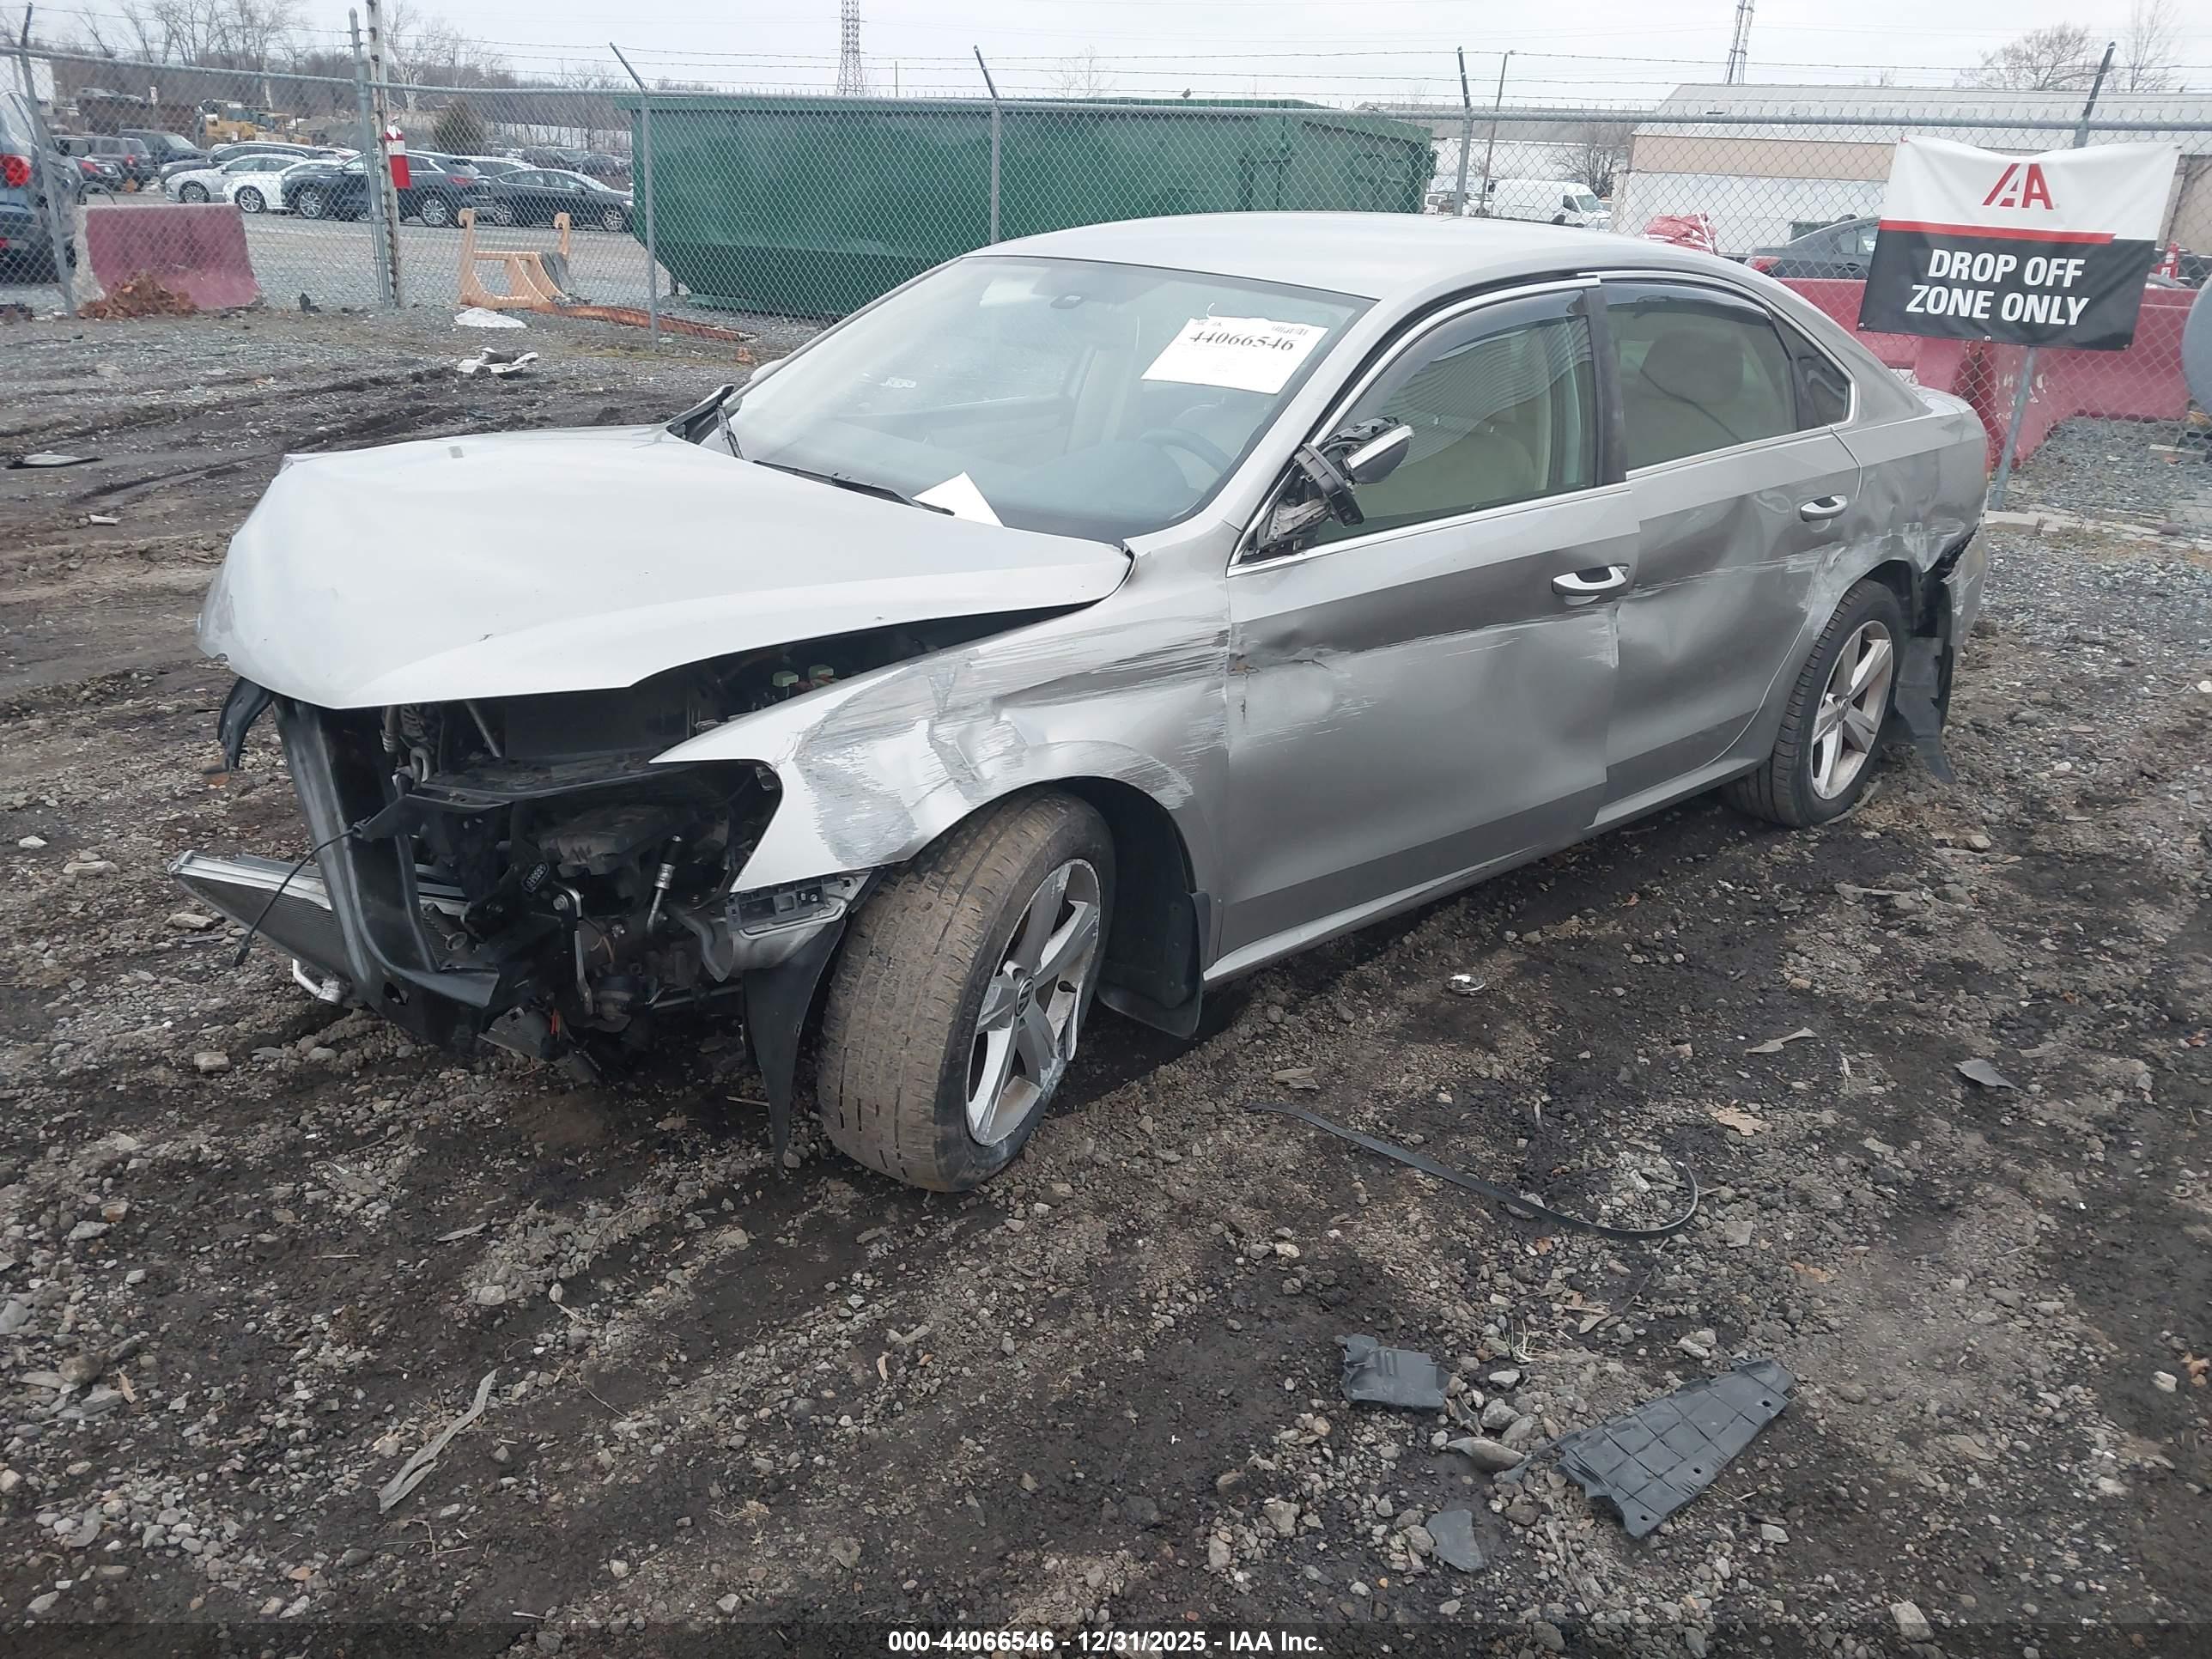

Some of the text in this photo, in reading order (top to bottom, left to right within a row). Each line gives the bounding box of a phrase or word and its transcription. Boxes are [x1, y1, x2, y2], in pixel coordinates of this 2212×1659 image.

[1928, 248, 2086, 289] DROP OFF
[1905, 284, 2090, 325] ZONE ONLY
[1189, 331, 1298, 351] 44066546
